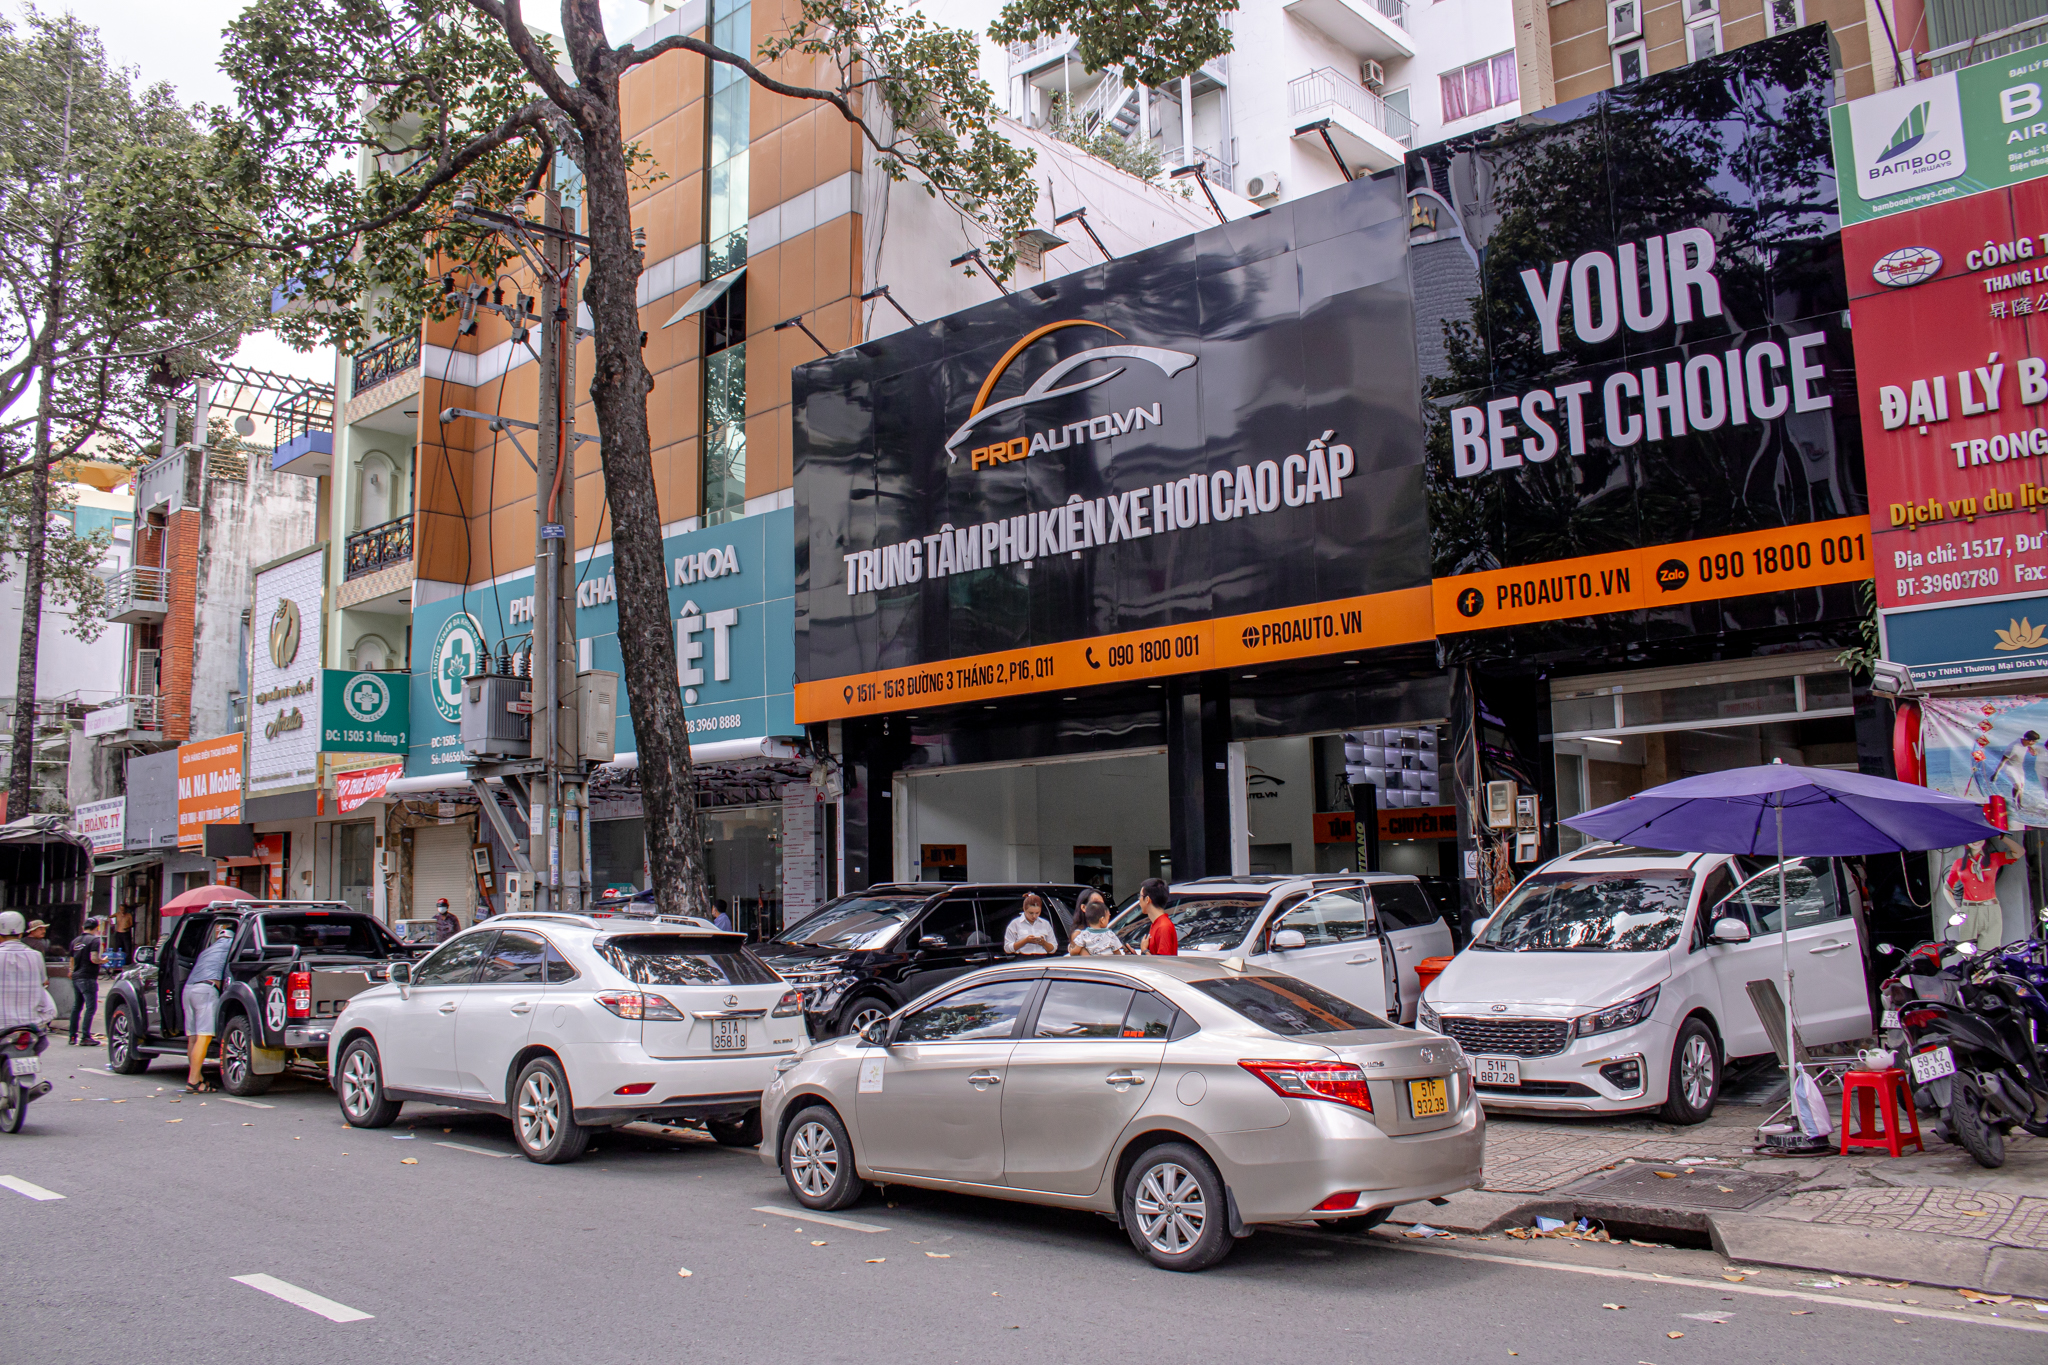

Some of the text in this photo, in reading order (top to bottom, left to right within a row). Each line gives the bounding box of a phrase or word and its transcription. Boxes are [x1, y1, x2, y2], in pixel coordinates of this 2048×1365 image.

[1869, 150, 1951, 180] BAMBOO
[1912, 160, 1952, 175] AIRWAYS
[1872, 186, 1956, 212] bambooairways.com
[1966, 240, 2034, 271] CÔNG
[1520, 227, 1723, 355] YOUR
[1984, 270, 2032, 294] THANG
[1450, 330, 1832, 478] BEST CHOICE
[1880, 375, 1950, 435] ĐẠI
[1958, 351, 2004, 416] LÝ
[971, 402, 1162, 471] PROAUTO.VN
[1950, 428, 2048, 469] TRONG
[843, 429, 1354, 596] TRUNG TÂM PHỤ KIỆN XE HƠI CAO CẤP
[1890, 498, 1944, 532] Dịch
[1948, 497, 1978, 523] vụ
[1983, 488, 2014, 513] du
[1894, 550, 1923, 572] Địa
[1927, 543, 1957, 564] chỉ:
[576, 566, 617, 609] KHÁ
[674, 544, 740, 586] KHOA
[1496, 533, 1866, 610] PROAUTO.VN Zalo 090 1800 001
[676, 600, 738, 704] ỆT
[907, 670, 944, 696] ĐƯỜNG
[946, 671, 954, 690] 3
[956, 664, 994, 689] THÁNG
[1036, 656, 1054, 678] Q11
[1108, 644, 1134, 668] 090
[1138, 638, 1170, 663] 1800
[1175, 634, 1200, 658] 001
[1262, 610, 1362, 646] PROAUTO.VN
[1910, 670, 1926, 680] ông
[1928, 670, 1937, 678] ty
[1938, 668, 1962, 676] TNHH
[1964, 665, 1996, 674] Thương
[1998, 662, 2014, 671] Mại
[696, 717, 718, 732] 3960
[719, 714, 742, 730] 8888
[326, 730, 406, 746] ĐC: 1505 3 tháng 2
[178, 777, 192, 800] NA
[194, 774, 207, 798] NA
[209, 768, 241, 794] Mobile
[84, 814, 108, 832] HOÀNG
[1328, 817, 1350, 840] TẬN
[1388, 813, 1438, 834] CHUYÊN
[714, 1034, 746, 1048] 358.18
[720, 1021, 738, 1034] 51A
[1487, 1060, 1507, 1072] 51H
[1916, 1050, 1946, 1068] 59-K2
[1917, 1061, 1952, 1080] 293.39
[1420, 1082, 1436, 1098] 51F
[1480, 1072, 1515, 1083] 887.28
[1416, 1097, 1445, 1115] 932.39
